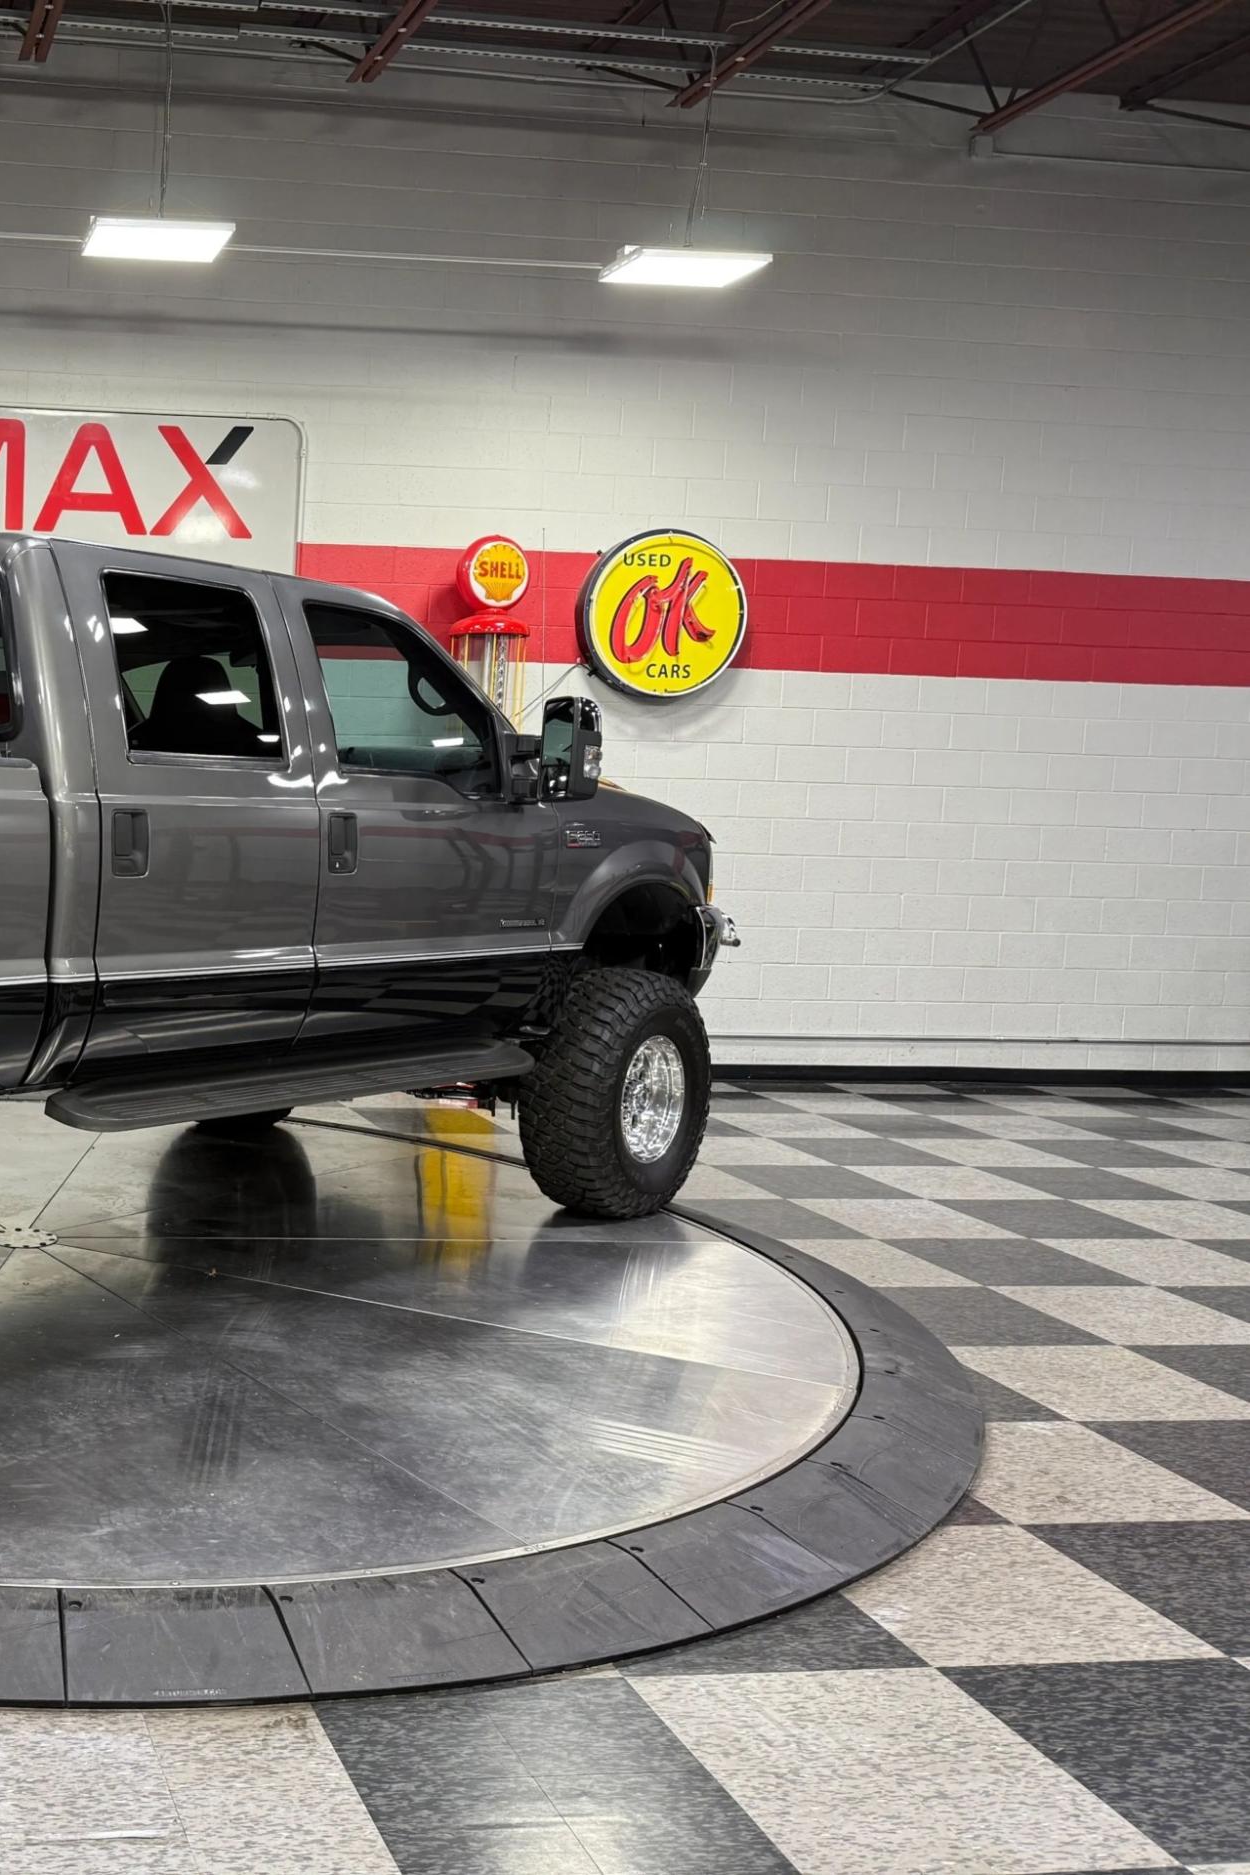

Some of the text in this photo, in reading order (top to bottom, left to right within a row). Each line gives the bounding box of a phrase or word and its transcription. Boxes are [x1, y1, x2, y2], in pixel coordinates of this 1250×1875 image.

[623, 552, 672, 568] USED
[478, 560, 522, 580] SHELL
[610, 557, 716, 664] OK
[646, 663, 692, 680] CARS
